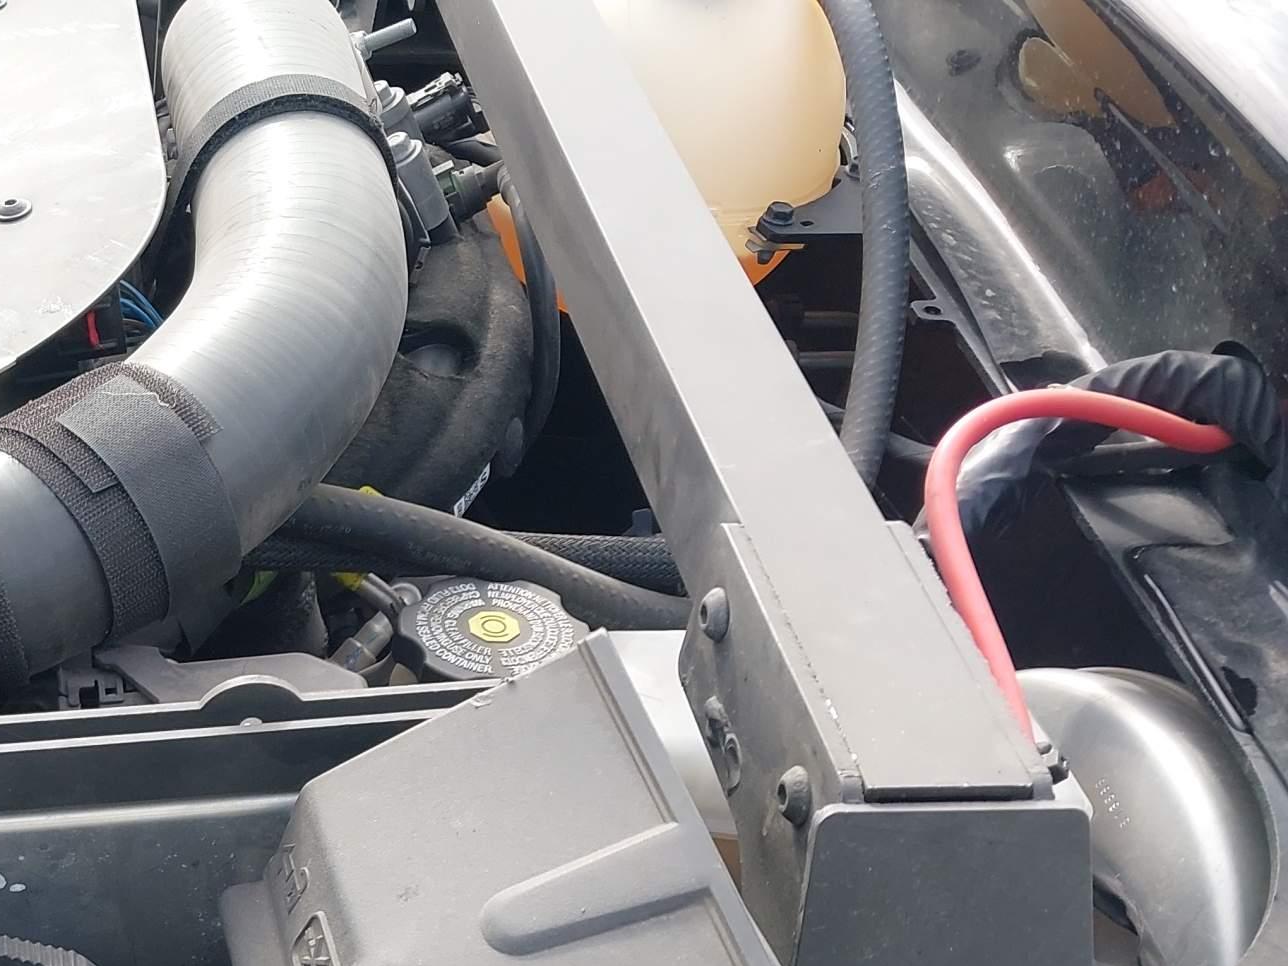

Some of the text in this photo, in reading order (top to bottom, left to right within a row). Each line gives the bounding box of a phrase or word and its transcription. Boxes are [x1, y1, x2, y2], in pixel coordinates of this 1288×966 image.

[488, 583, 536, 598] ATTENTION
[446, 643, 467, 656] USE
[465, 651, 493, 664] ONLY
[457, 638, 492, 655] FILLER
[435, 648, 494, 674] CONTAINER
